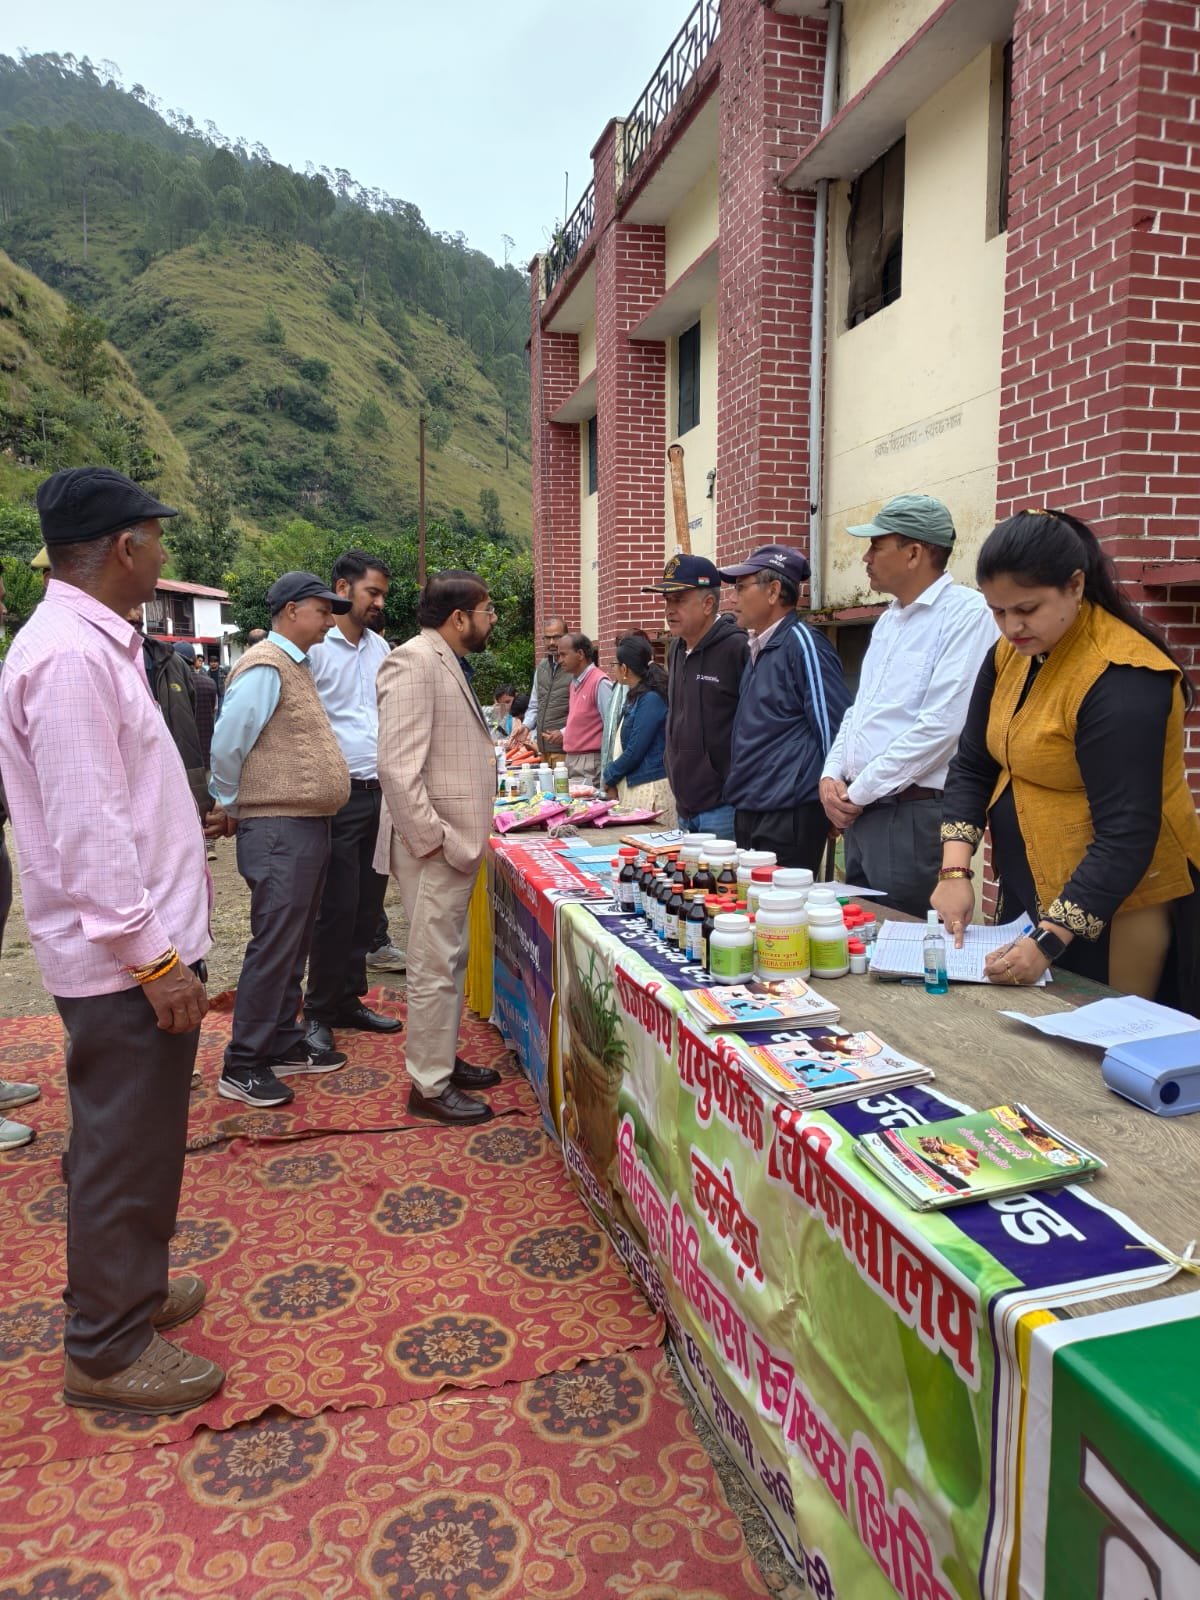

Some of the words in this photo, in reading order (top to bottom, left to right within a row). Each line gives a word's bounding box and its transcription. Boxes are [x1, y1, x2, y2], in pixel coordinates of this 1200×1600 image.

[615, 964, 672, 1056] राजकीय
[767, 1102, 978, 1378] चिकित्सालय
[671, 1202, 750, 1380] चिकित्सा
